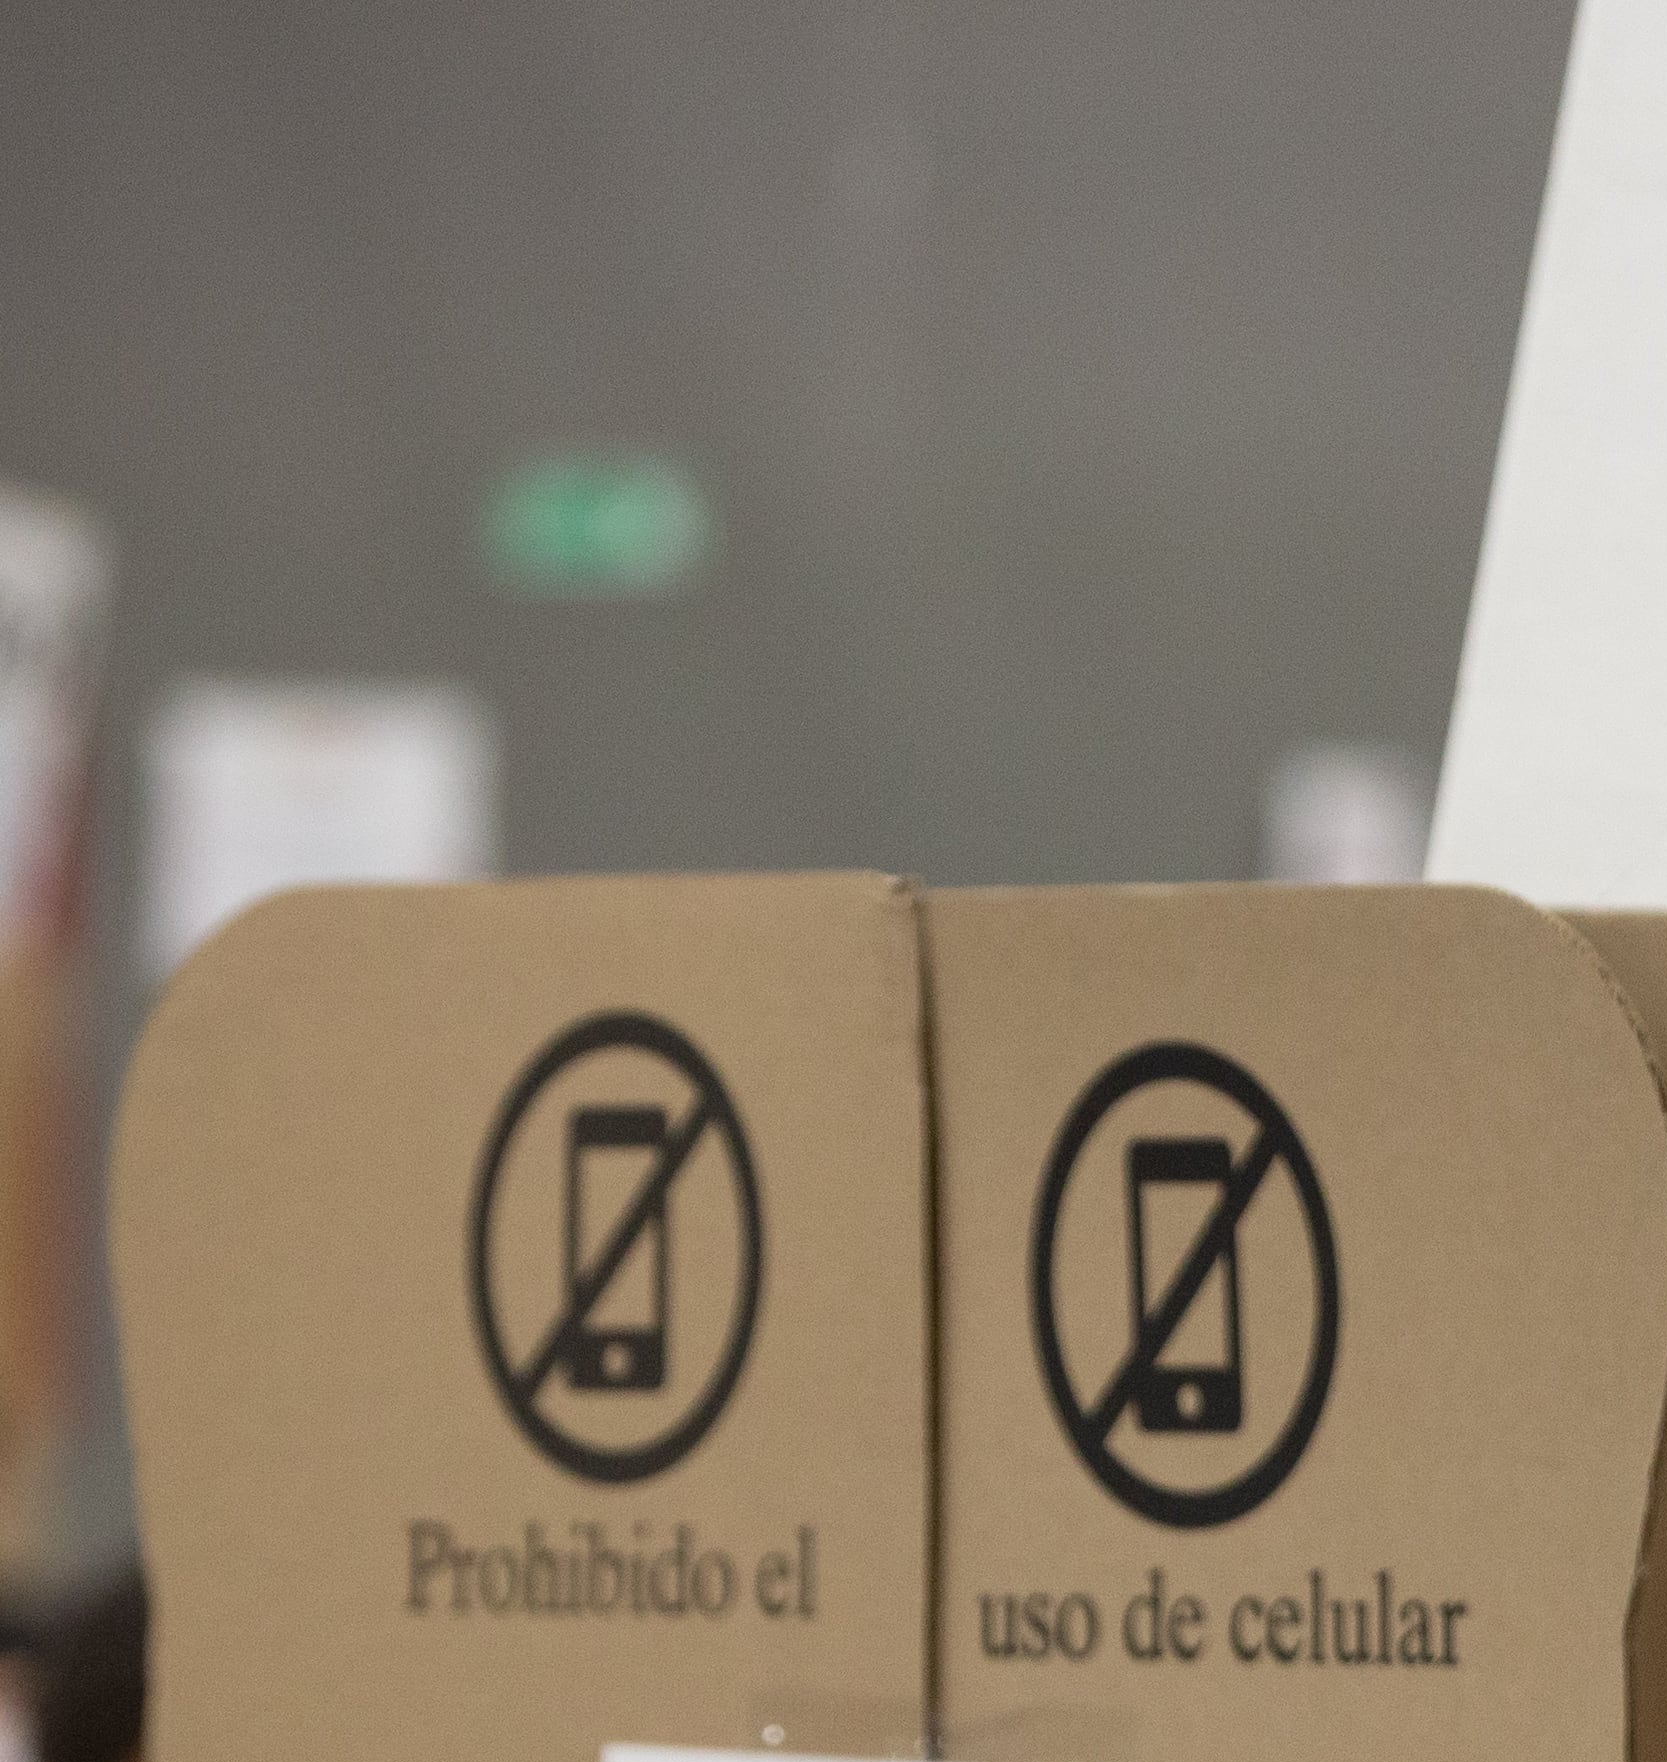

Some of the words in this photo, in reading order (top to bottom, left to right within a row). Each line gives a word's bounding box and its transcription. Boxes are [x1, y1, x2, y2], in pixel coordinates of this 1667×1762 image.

[407, 1516, 737, 1620] Prohibido
[754, 1520, 819, 1620] el
[978, 1592, 1101, 1661] uso
[1120, 1566, 1205, 1664] de
[1228, 1566, 1468, 1668] celular
